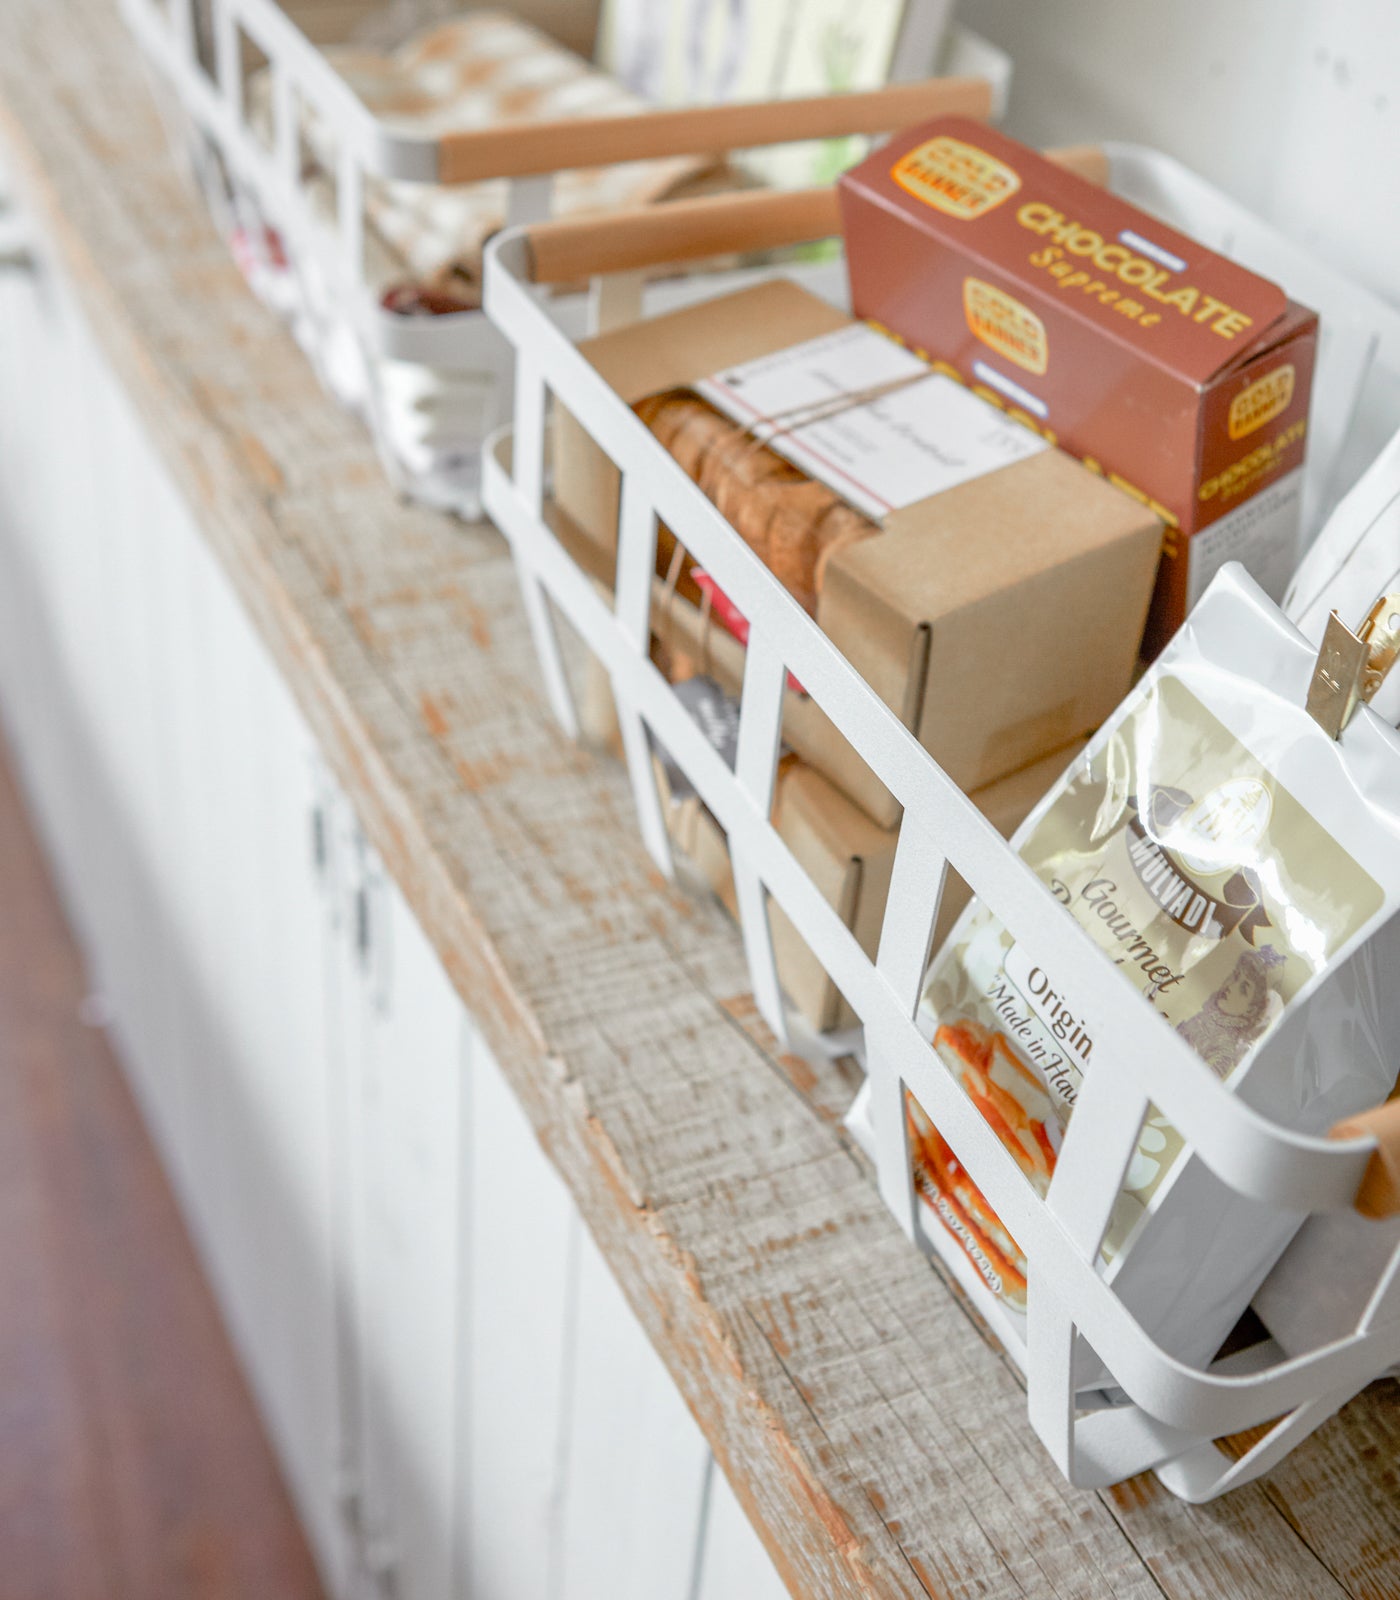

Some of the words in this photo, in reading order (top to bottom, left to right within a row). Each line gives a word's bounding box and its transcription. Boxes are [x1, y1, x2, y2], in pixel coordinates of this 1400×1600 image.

[1016, 202, 1253, 339] CHOCOLATE
[1029, 246, 1162, 328] Supreme
[1130, 837, 1217, 934] MULVADI
[1081, 879, 1184, 993] Gourmet
[1027, 1037, 1047, 1061] in
[1028, 967, 1092, 1065] Origin
